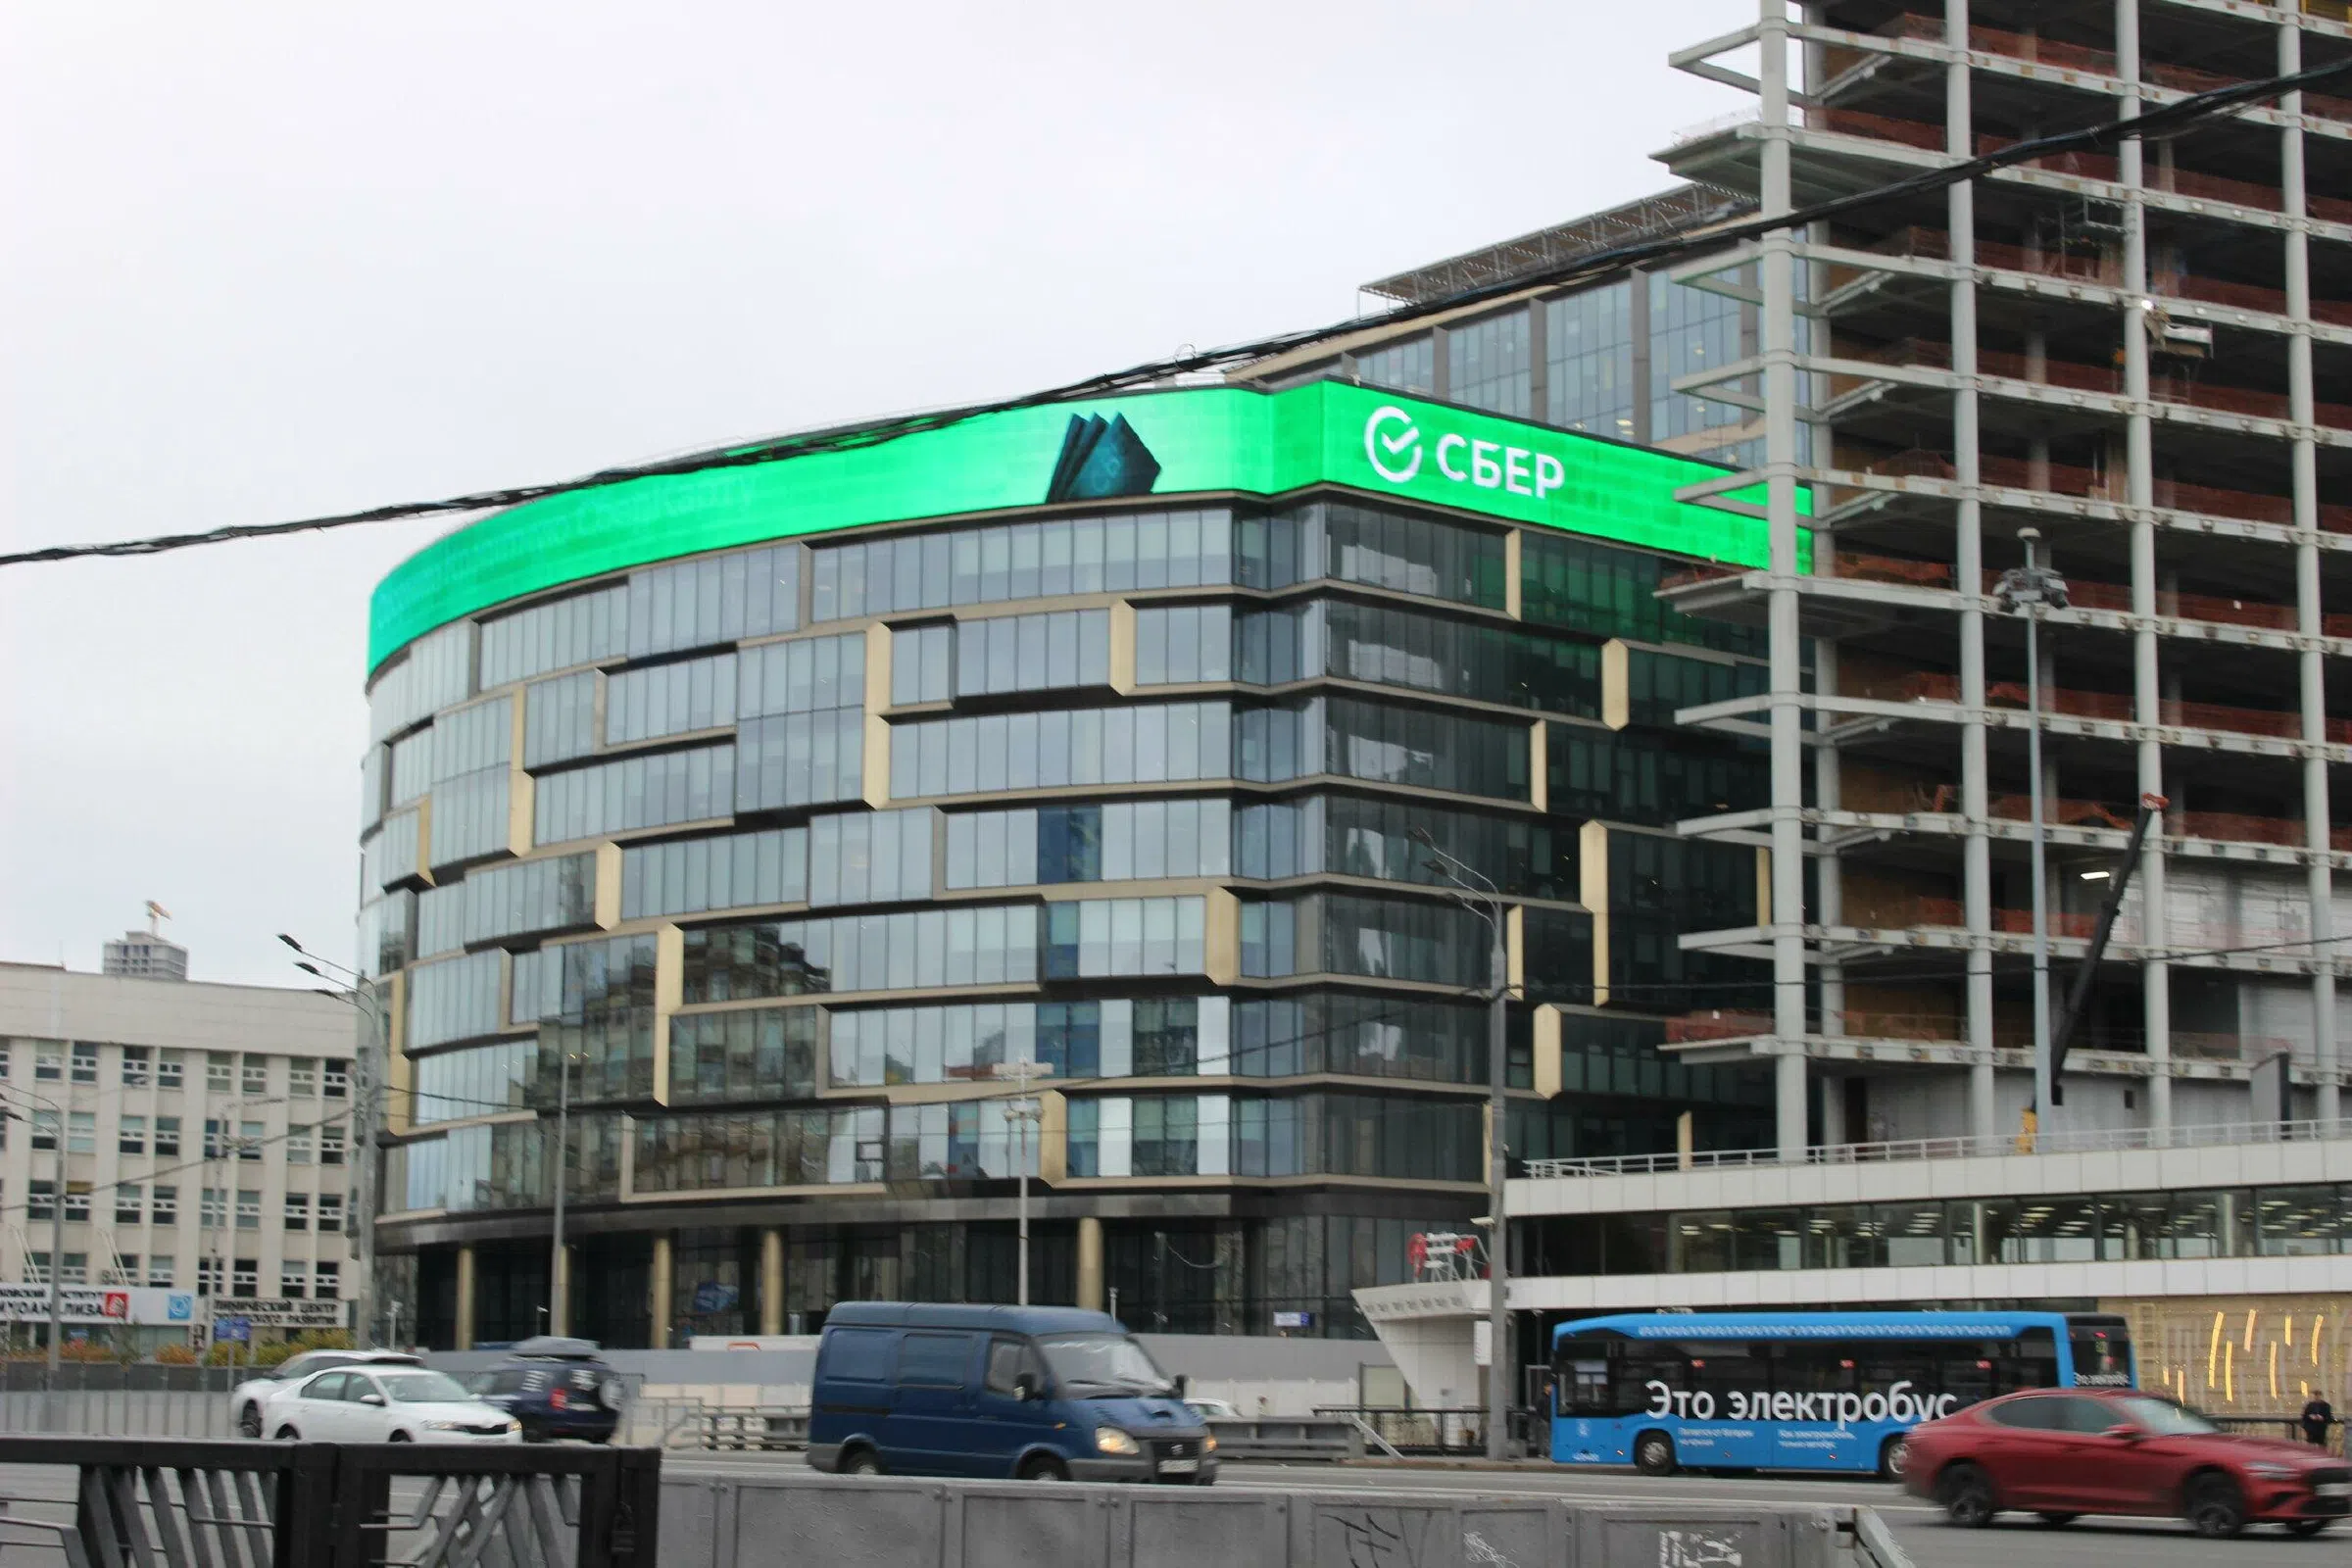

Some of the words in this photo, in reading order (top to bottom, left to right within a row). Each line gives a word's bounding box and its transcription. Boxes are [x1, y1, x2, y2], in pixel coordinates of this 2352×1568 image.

[1436, 433, 1565, 499] СБЕР
[1645, 1380, 1715, 1420] Это
[1727, 1381, 1958, 1432] электробус
